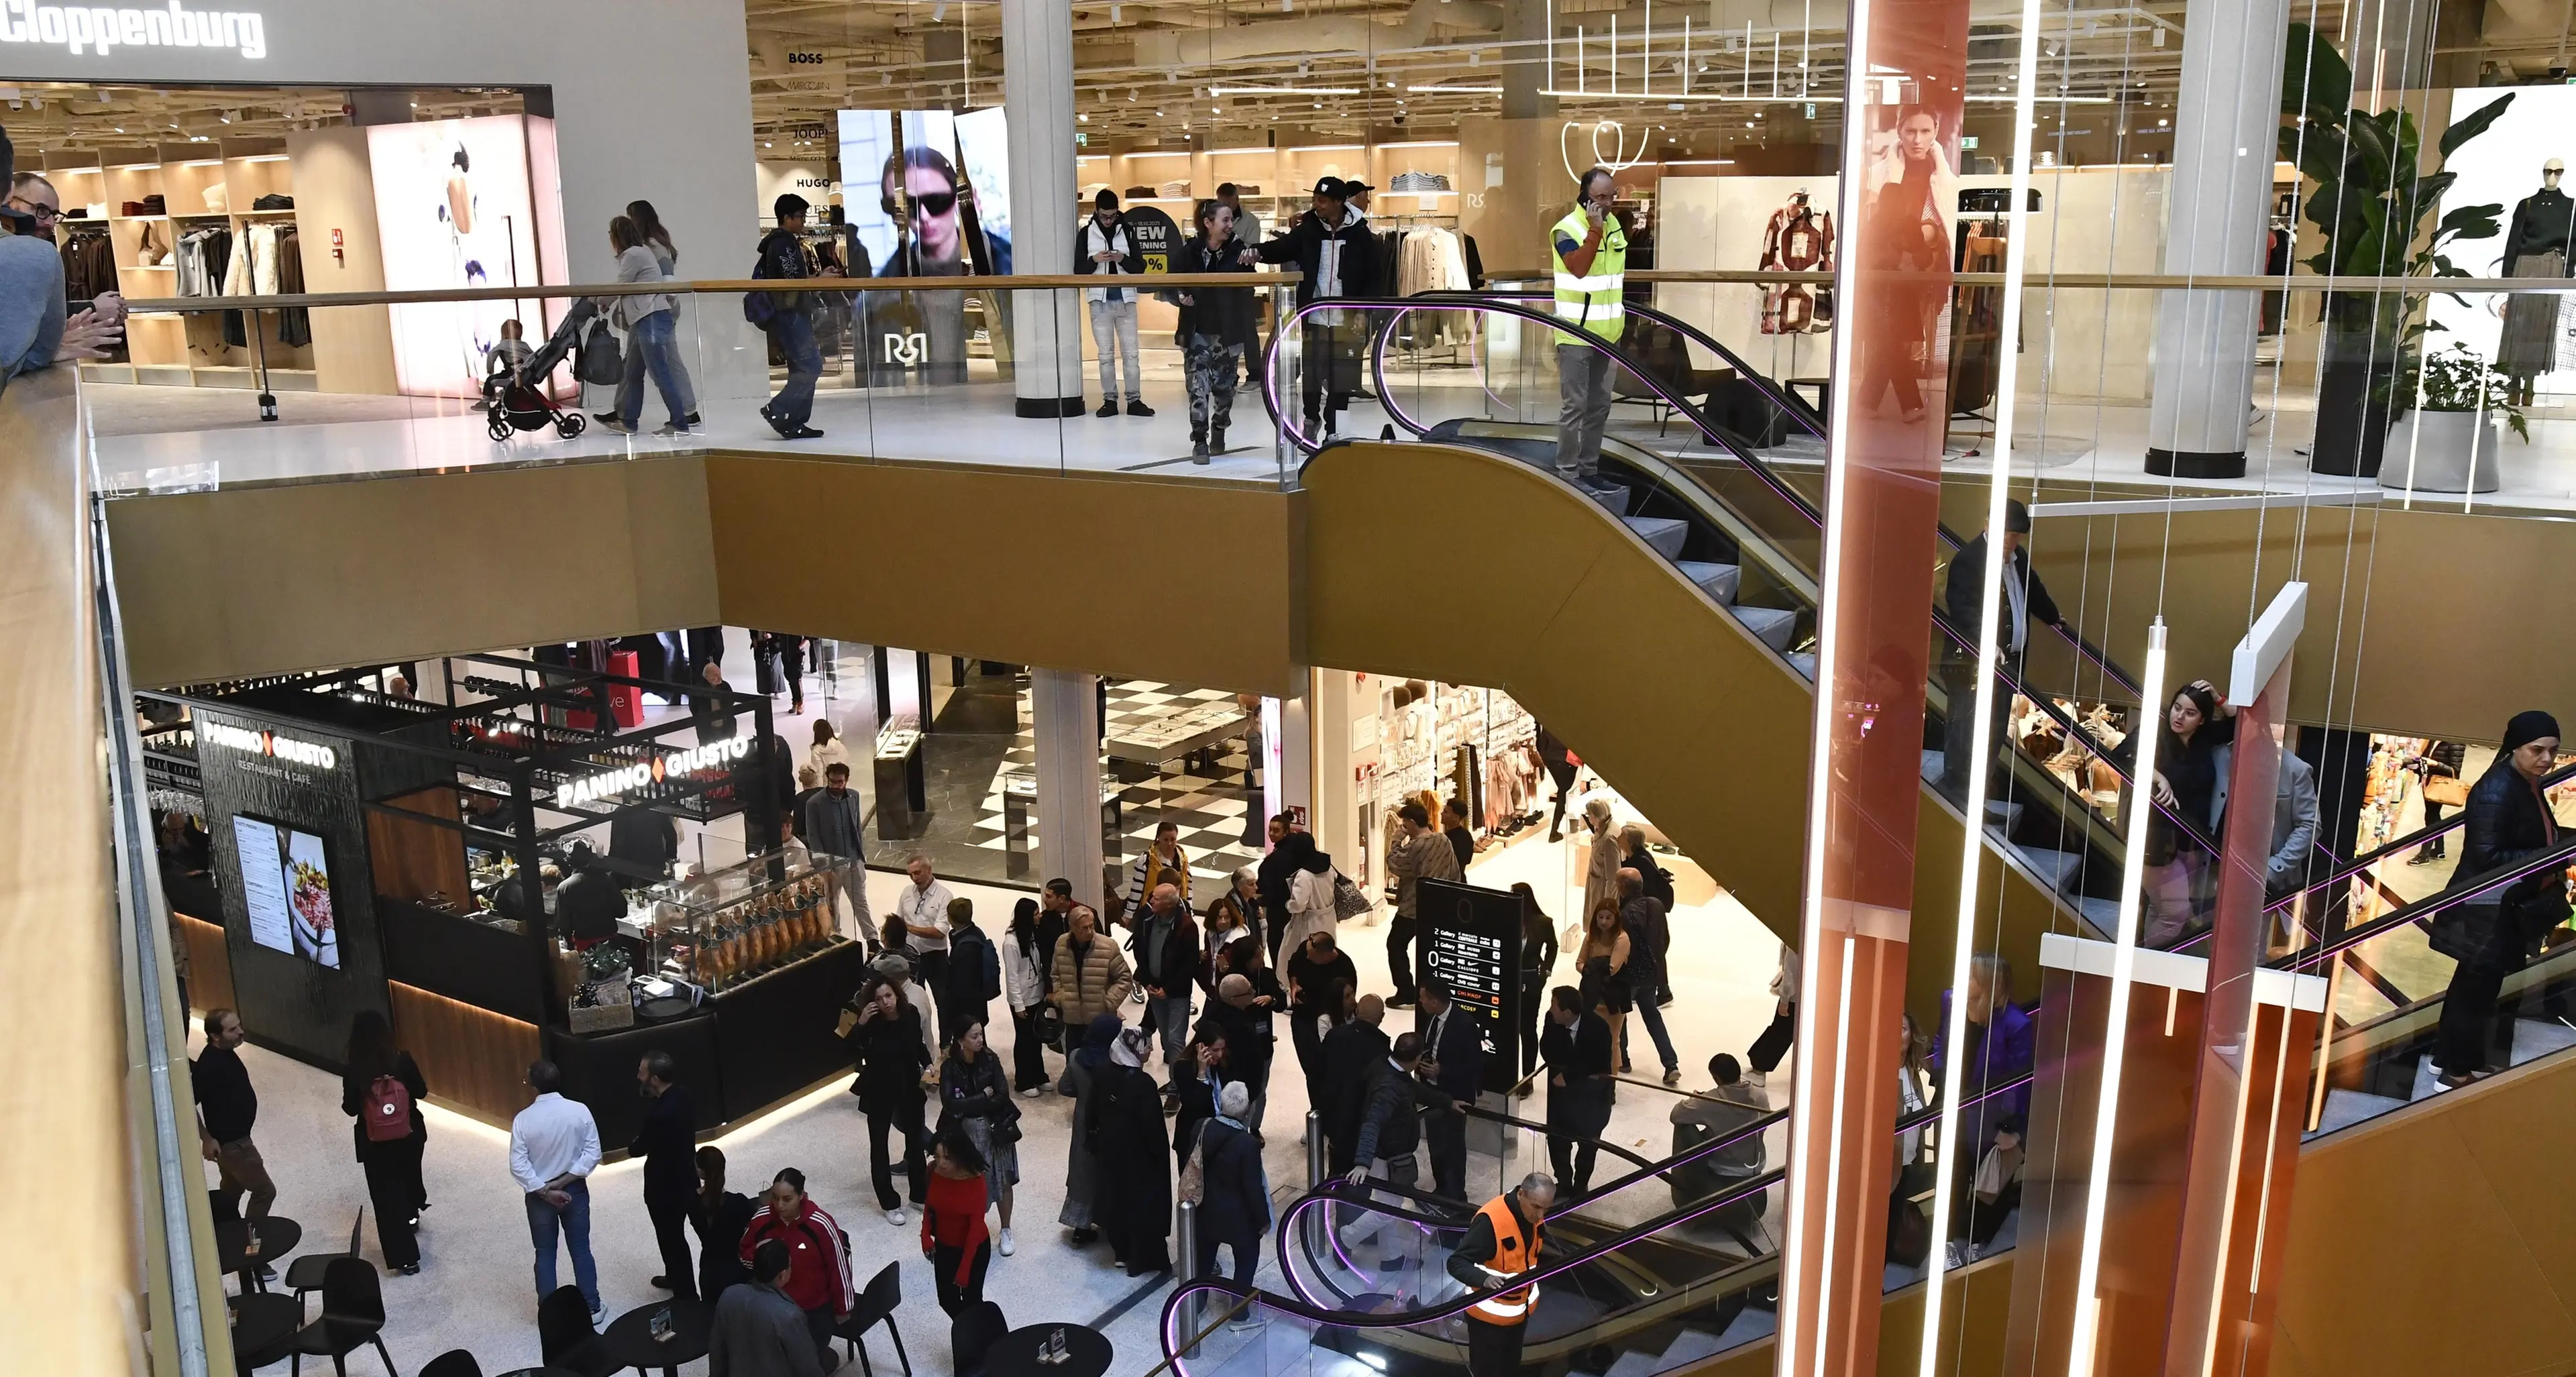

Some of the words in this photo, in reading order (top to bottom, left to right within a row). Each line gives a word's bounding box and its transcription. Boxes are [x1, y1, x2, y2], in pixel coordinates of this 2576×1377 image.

[0, 0, 266, 58] Cloppenburg
[788, 53, 823, 64] BOSS
[793, 128, 828, 140] JOOP!
[797, 178, 830, 188] HUGO
[202, 721, 264, 753] PANINO
[272, 736, 335, 769] GIUSTO
[237, 760, 282, 779] RESTAURANT
[557, 763, 651, 808] PANINO
[665, 735, 748, 777] GIUSTO
[1440, 930, 1456, 938] Gallery
[1440, 942, 1456, 950] Gallery
[1428, 950, 1439, 967] 0
[1440, 957, 1455, 966] Gallery
[1457, 965, 1479, 973] CALLIOPE
[1440, 972, 1455, 981] Gallery
[1458, 1003, 1477, 1012] BCDEF
